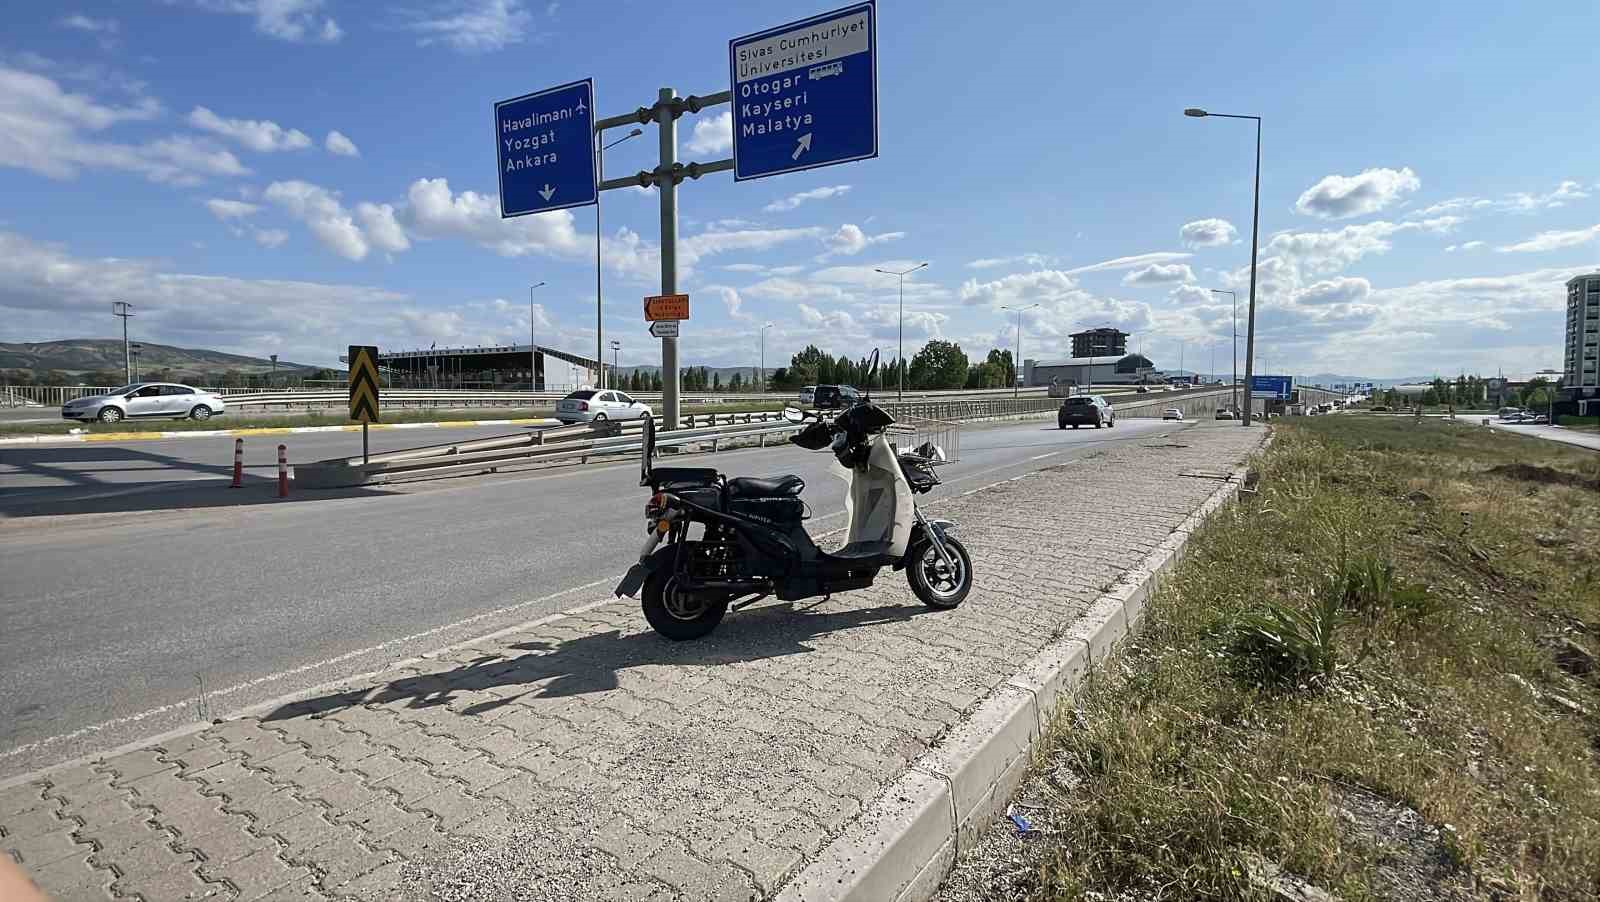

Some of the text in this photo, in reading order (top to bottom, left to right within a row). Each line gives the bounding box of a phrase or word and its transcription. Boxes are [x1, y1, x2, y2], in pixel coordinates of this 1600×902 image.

[739, 19, 865, 62] Sivas Cumhuriyet
[740, 47, 828, 77] Üniversitesi
[741, 74, 801, 98] Otogar
[742, 91, 808, 118] Kayseri
[502, 108, 572, 133] Havalimanı
[743, 113, 813, 138] Malatya
[504, 130, 555, 152] Yozgat
[505, 152, 557, 173] Ankara
